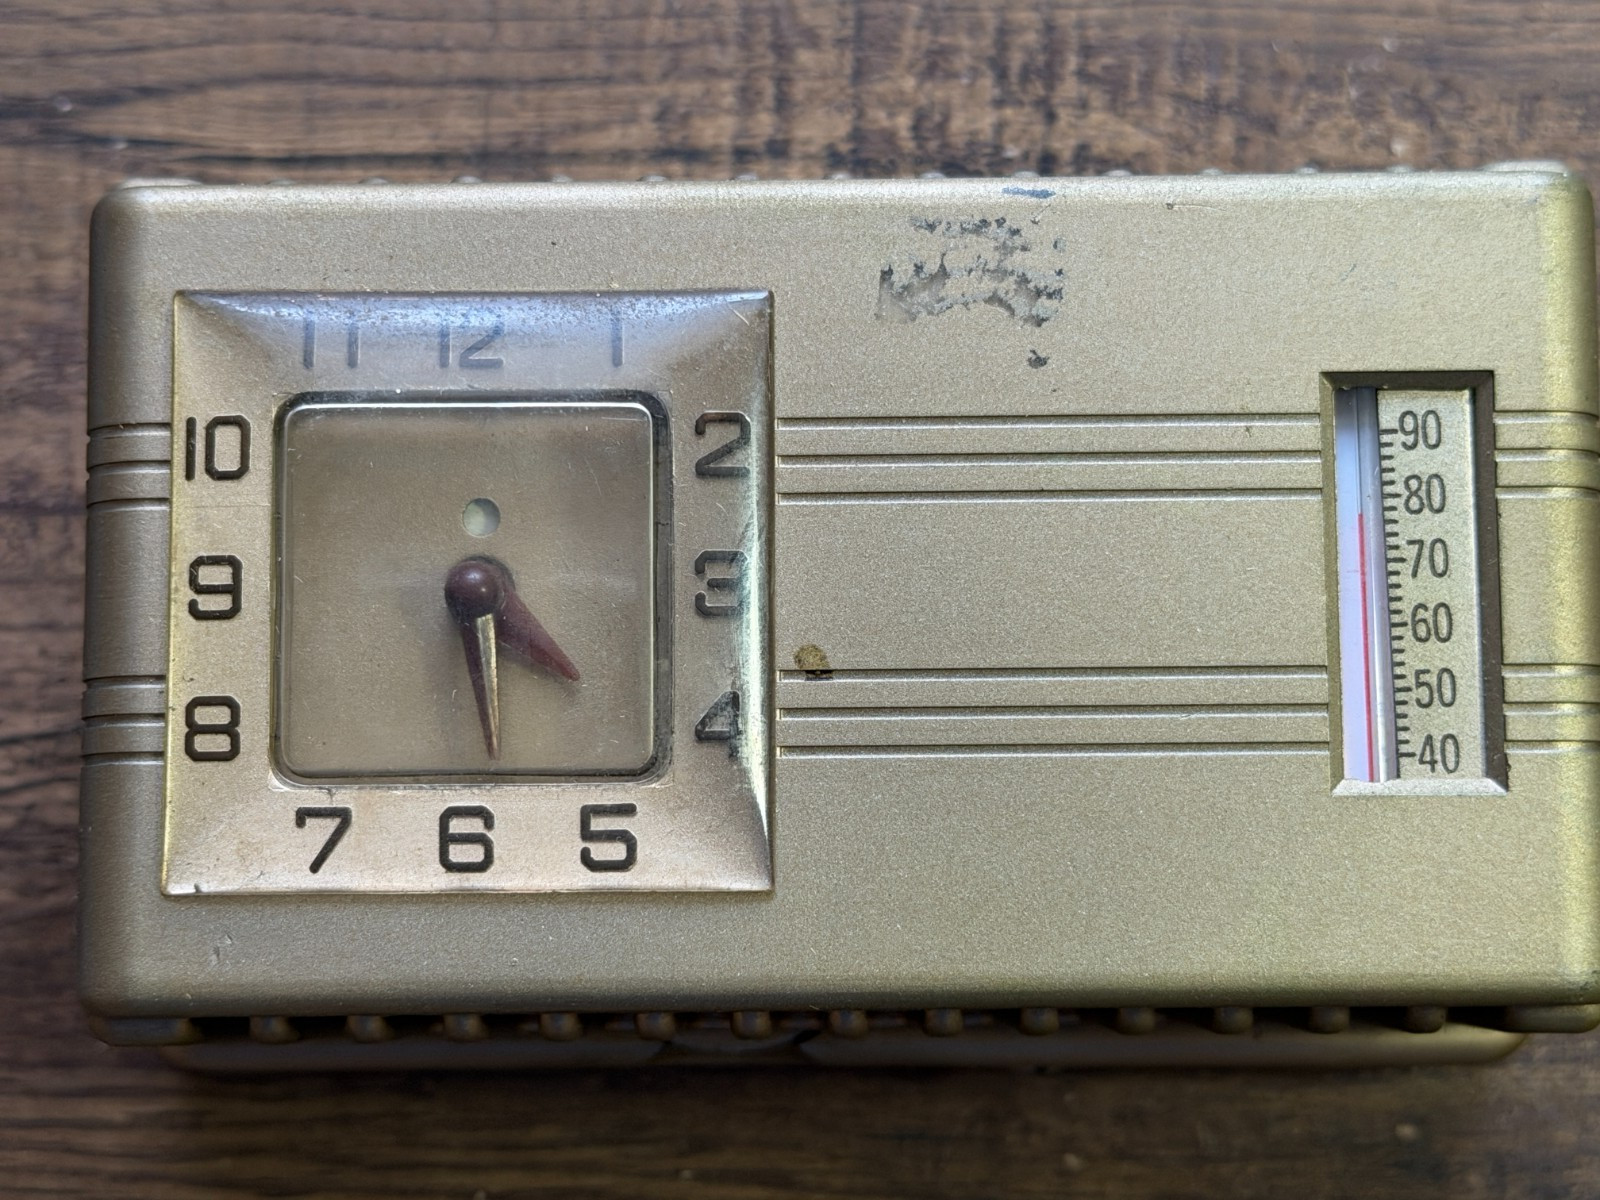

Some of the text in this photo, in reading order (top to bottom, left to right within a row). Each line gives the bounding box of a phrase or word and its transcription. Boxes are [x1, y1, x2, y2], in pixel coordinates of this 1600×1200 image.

[303, 313, 360, 368] 11
[438, 313, 504, 368] 12
[186, 415, 251, 480] 10
[694, 412, 751, 476] 2
[1399, 410, 1442, 450] 90
[1404, 474, 1446, 515] 80
[188, 555, 243, 620] 9
[694, 550, 752, 617] 3
[1406, 538, 1450, 578] 70
[1411, 602, 1453, 643] 60
[1415, 668, 1456, 708] 50
[185, 696, 240, 761] 8
[694, 690, 754, 759] 4
[1419, 734, 1460, 774] 40
[295, 806, 352, 873] 7
[438, 805, 495, 872] 6
[580, 803, 637, 871] 5
